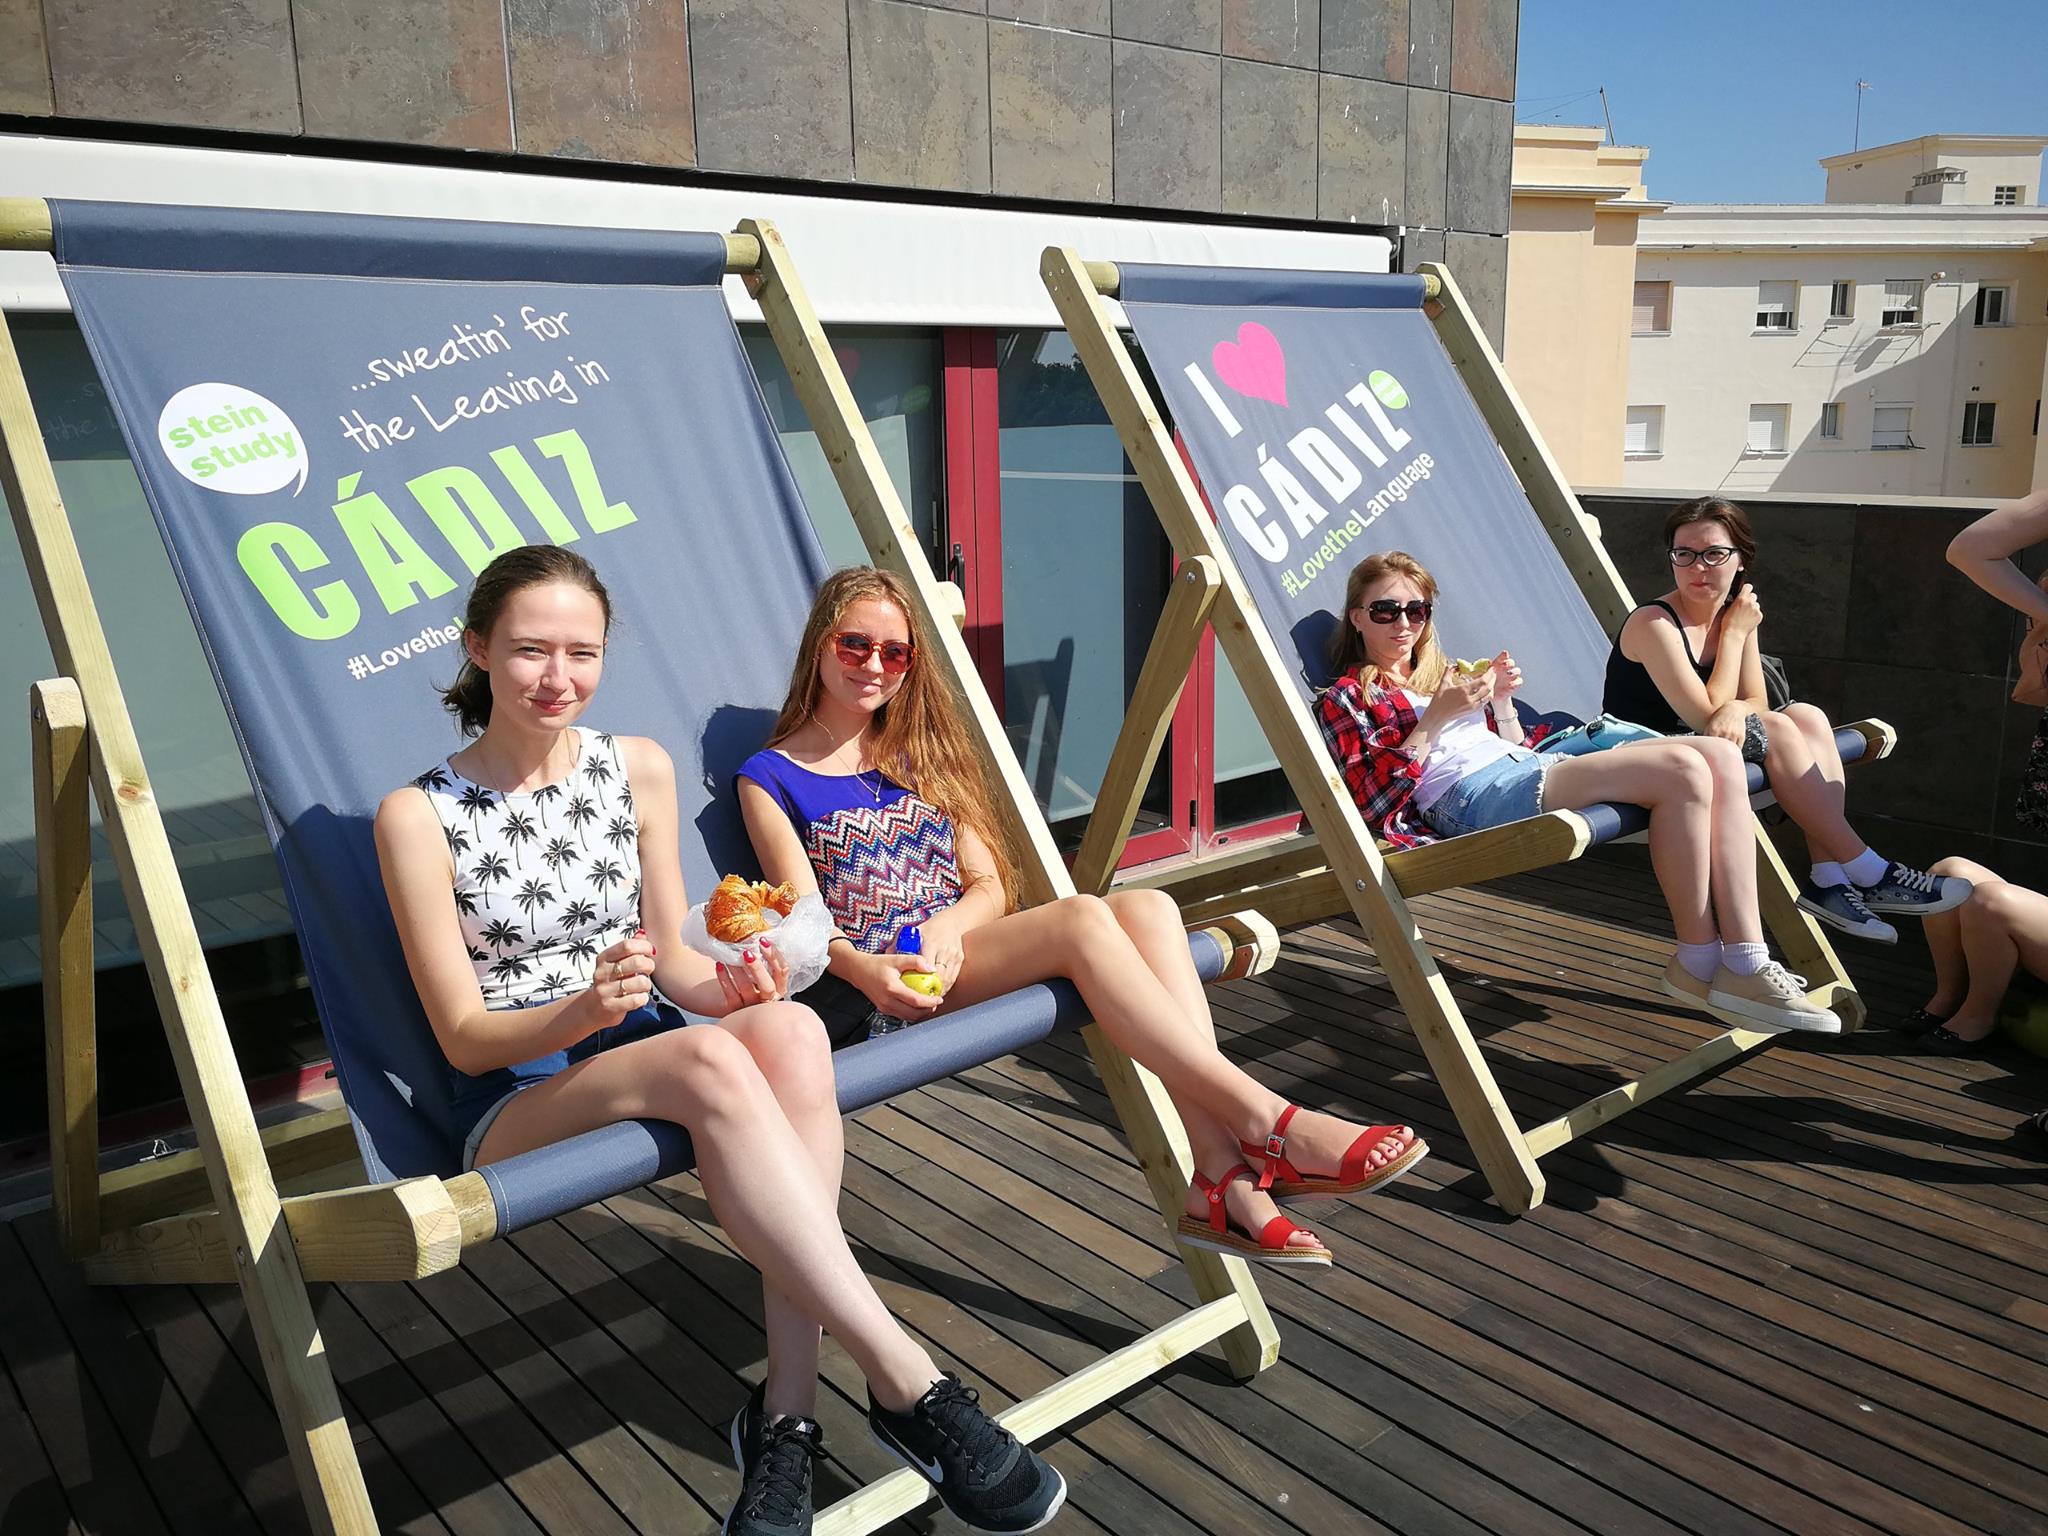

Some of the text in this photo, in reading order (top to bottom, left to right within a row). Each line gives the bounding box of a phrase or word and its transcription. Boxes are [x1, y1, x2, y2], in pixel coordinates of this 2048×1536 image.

[520, 306, 570, 341] for
[168, 405, 268, 448] stein
[339, 355, 610, 452] the Leaving in
[1184, 361, 1243, 438] I
[191, 431, 297, 477] study
[1223, 382, 1413, 563] CÁDIZ
[237, 428, 638, 640] CÁDIZ
[1281, 452, 1435, 599] #LovetheLanguage
